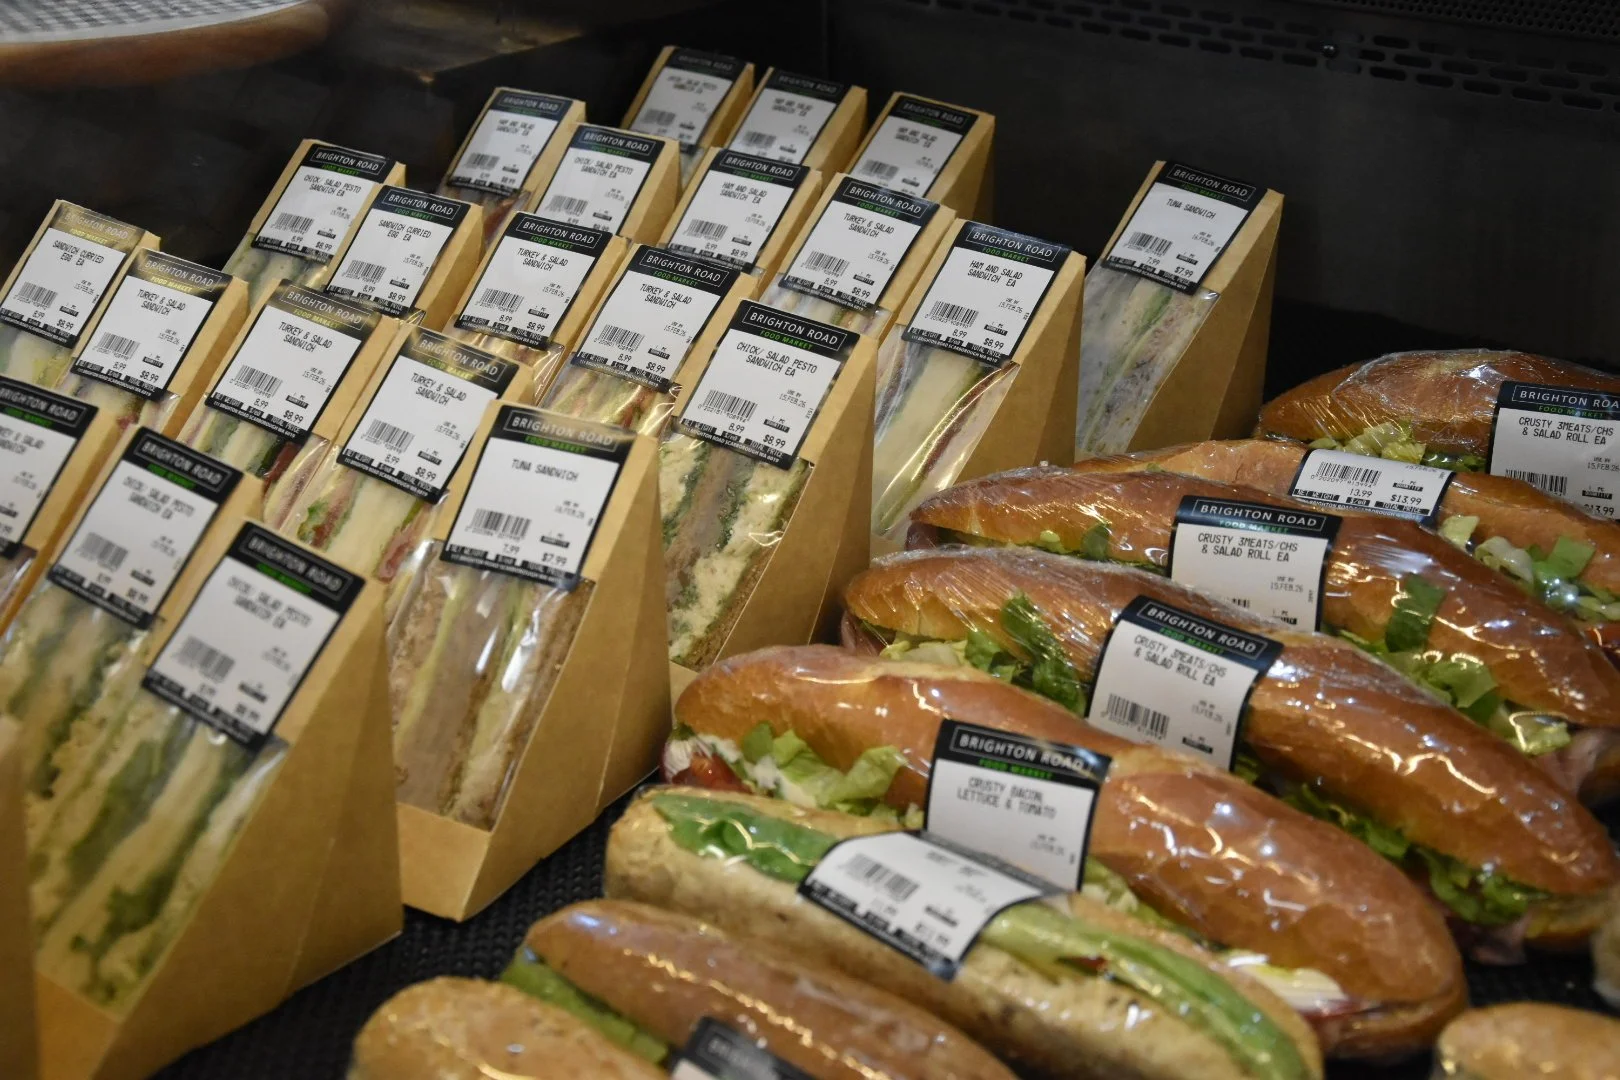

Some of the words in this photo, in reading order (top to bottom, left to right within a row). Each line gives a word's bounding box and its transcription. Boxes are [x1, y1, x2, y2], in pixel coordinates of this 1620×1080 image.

[501, 96, 537, 107] BRIGHTON
[537, 101, 559, 110] ROAD
[583, 133, 623, 146] BRIGHTON
[624, 141, 648, 151] ROAD
[315, 152, 355, 165] BRIGHTON
[355, 160, 378, 170] ROAD
[725, 156, 768, 171] BRIGHTON
[768, 165, 793, 176] ROAD
[308, 183, 336, 195] SANDWICH
[325, 179, 343, 188] SALAD
[343, 184, 361, 193] PESTO
[721, 182, 734, 190] HAM
[735, 185, 748, 193] AND
[748, 188, 768, 198] SALAD
[1172, 168, 1220, 188] BRIGHTON
[1220, 183, 1249, 196] ROAD
[387, 194, 428, 209] BRIGHTON
[429, 204, 453, 215] ROAD
[719, 189, 748, 201] SANDWICH
[848, 187, 894, 205] BRIGHTON
[894, 200, 921, 213] ROAD
[1165, 198, 1183, 209] TUNA
[1184, 204, 1217, 219] SANDWICH
[377, 219, 406, 232] SANDWICH
[406, 226, 432, 238] CURRIED
[522, 221, 567, 238] BRIGHTON
[568, 232, 594, 244] ROAD
[843, 213, 867, 225] TURKEY
[874, 223, 895, 234] SALAD
[848, 223, 879, 237] SANDWICH
[386, 230, 399, 238] EGG
[972, 232, 1022, 250] BRIGHTON
[1023, 244, 1052, 257] ROAD
[517, 248, 541, 259] TURKEY
[548, 256, 568, 266] SALAD
[522, 258, 553, 271] SANDWICH
[143, 260, 188, 279] BRIGHTON
[188, 273, 214, 287] ROAD
[645, 255, 692, 274] BRIGHTON
[692, 268, 720, 281] ROAD
[966, 268, 1001, 283] SANDWICH
[1006, 279, 1017, 287] EA
[969, 260, 983, 269] HAM
[985, 264, 1000, 273] AND
[1001, 268, 1023, 280] SALAD
[1173, 266, 1194, 276] $7.99
[653, 271, 671, 279] FOOD
[671, 275, 698, 286] MARKET
[136, 289, 160, 302] TURKEY
[167, 299, 187, 311] SALAD
[387, 292, 406, 301] $8.99
[639, 283, 664, 296] TURKEY
[671, 293, 692, 304] SALAD
[643, 294, 676, 309] SANDWICH
[850, 287, 871, 298] $8.99
[140, 300, 171, 315] SANDWICH
[285, 290, 334, 314] BRIGHTON
[334, 308, 363, 325] ROAD
[277, 321, 304, 337] TURKEY
[304, 332, 311, 340] &
[311, 335, 333, 349] SALAD
[525, 321, 546, 331] $8.99
[749, 312, 804, 335] BRIGHTON
[805, 329, 838, 345] ROAD
[282, 334, 316, 352] SANDWICH
[759, 330, 780, 340] FOOD
[781, 336, 813, 350] MARKET
[951, 329, 967, 338] 8.99
[982, 338, 1005, 349] $8.99
[417, 338, 468, 365] BRIGHTON
[468, 358, 498, 376] ROAD
[735, 341, 765, 356] CHICK/
[767, 351, 792, 365] SALAD
[793, 359, 818, 373] PESTO
[744, 354, 783, 372] SANDWICH
[785, 367, 796, 377] EA
[139, 370, 159, 381] $8.99
[645, 362, 666, 373] $8.99
[409, 372, 437, 389] TURKEY
[437, 383, 444, 392] &
[445, 387, 467, 401] SALAD
[414, 385, 450, 405] SANDWICH
[1520, 390, 1588, 406] BRIGHTON
[1593, 398, 1619, 408] ROA
[48, 404, 79, 421] ROAD
[253, 398, 269, 408] 8.99
[282, 410, 304, 423] $8.99
[511, 417, 574, 438] BRIGHTON
[577, 430, 613, 446] ROAD
[727, 423, 745, 433] 8.99
[762, 434, 787, 447] $8.99
[1518, 417, 1552, 429] CRUSTY
[1557, 422, 1613, 436] 3MEATS/CHS
[1522, 427, 1527, 436] &
[1533, 429, 1561, 440] SALAD
[1566, 432, 1588, 443] ROLL
[1594, 436, 1606, 445] EA
[140, 442, 191, 471] BRIGHTON
[190, 464, 221, 485] ROAD
[414, 466, 437, 480] $8.99
[510, 458, 533, 471] TUNA
[536, 463, 580, 481] SANDWICH
[1349, 488, 1372, 497] 13.99
[1391, 494, 1421, 505] $13.99
[1200, 505, 1272, 520] BRIGHTON
[1277, 515, 1317, 526] ROAD
[1198, 533, 1233, 544] CRUSTY
[1238, 538, 1298, 551] 3MEATS/CHS
[1201, 545, 1208, 554] &
[1213, 546, 1242, 557] SALAD
[1248, 550, 1271, 560] ROLL
[1277, 552, 1289, 562] EA
[247, 539, 305, 574] BRIGHTON
[305, 567, 341, 591] ROAD
[1148, 608, 1216, 639] BRIGHTON
[1218, 634, 1257, 653] ROAD
[1134, 635, 1167, 655] CRUSTY
[1145, 651, 1172, 669] SALAD
[1176, 665, 1197, 681] ROLL
[1203, 675, 1216, 687] EA
[960, 734, 1037, 760] BRIGHTON
[1041, 751, 1084, 771] ROAD
[968, 777, 1005, 792] CRUSTY
[957, 787, 1000, 808] LETTUCE
[1018, 801, 1057, 819] TOMATO
